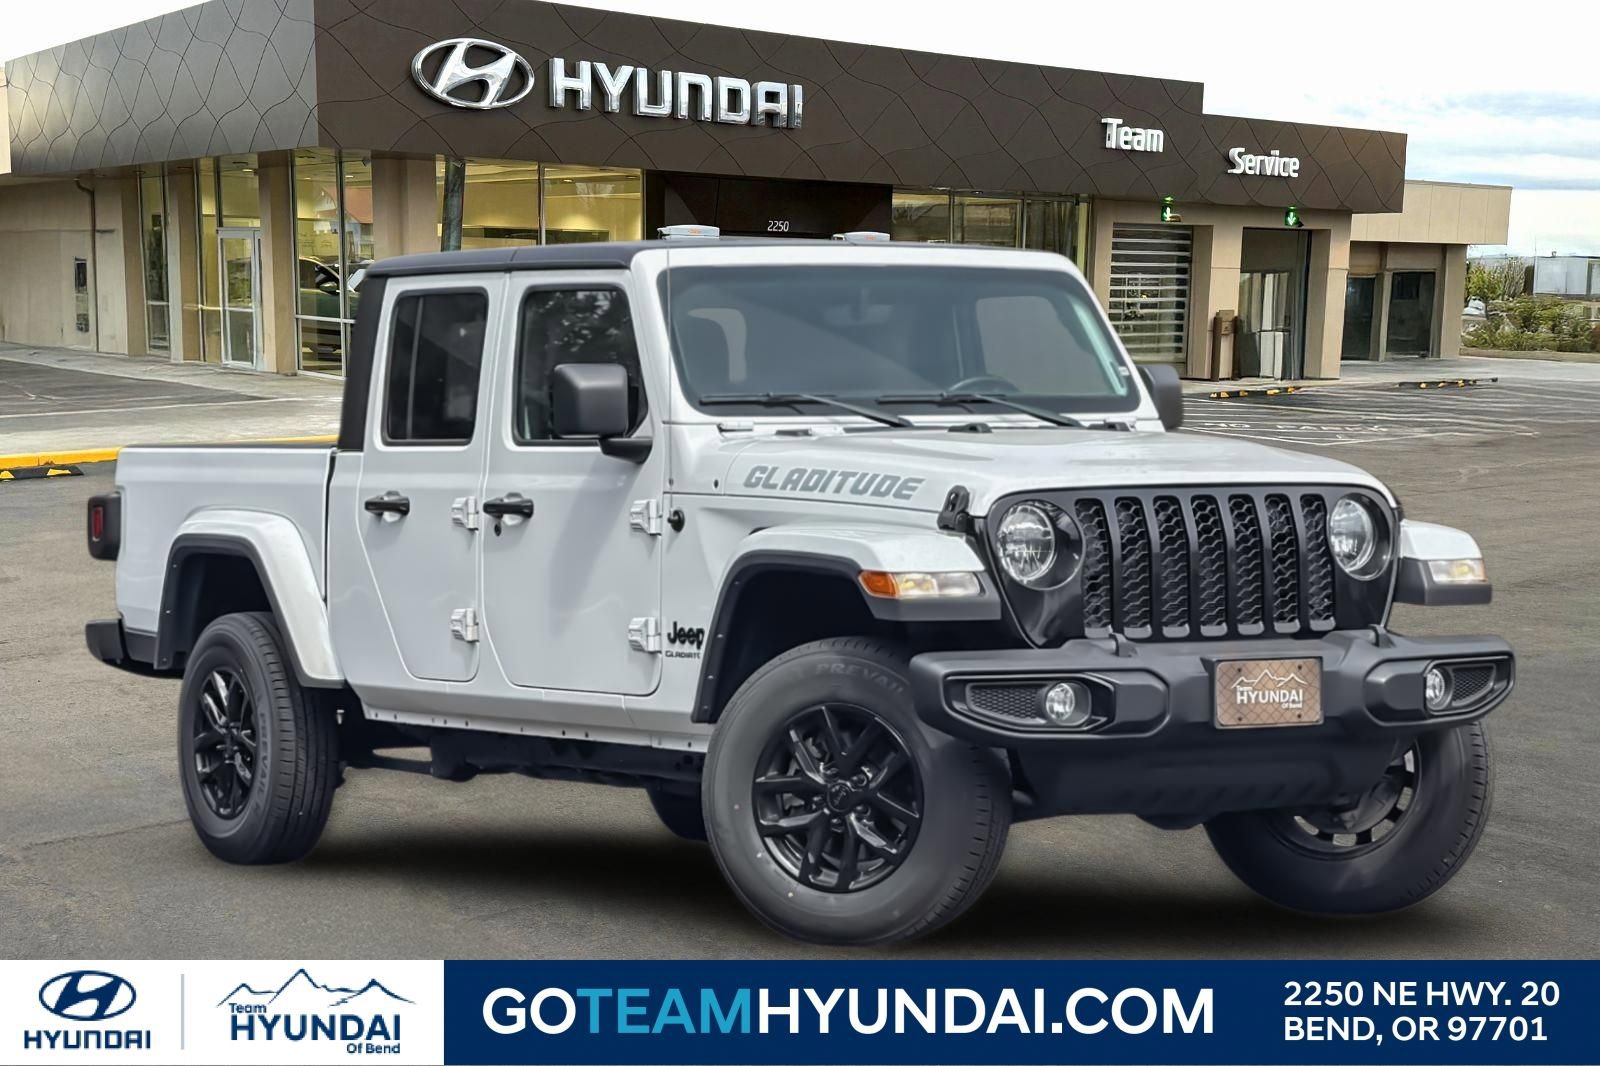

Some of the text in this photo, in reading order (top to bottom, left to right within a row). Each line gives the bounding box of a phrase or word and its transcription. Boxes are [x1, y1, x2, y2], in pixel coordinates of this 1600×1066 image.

[548, 57, 804, 129] HYUNDAI
[1101, 117, 1164, 153] Team
[1227, 147, 1300, 178] Service
[767, 220, 790, 232] 2250
[743, 465, 926, 500] GLADITUDE
[667, 620, 705, 650] Jeep
[1236, 689, 1304, 704] HYUNDAI
